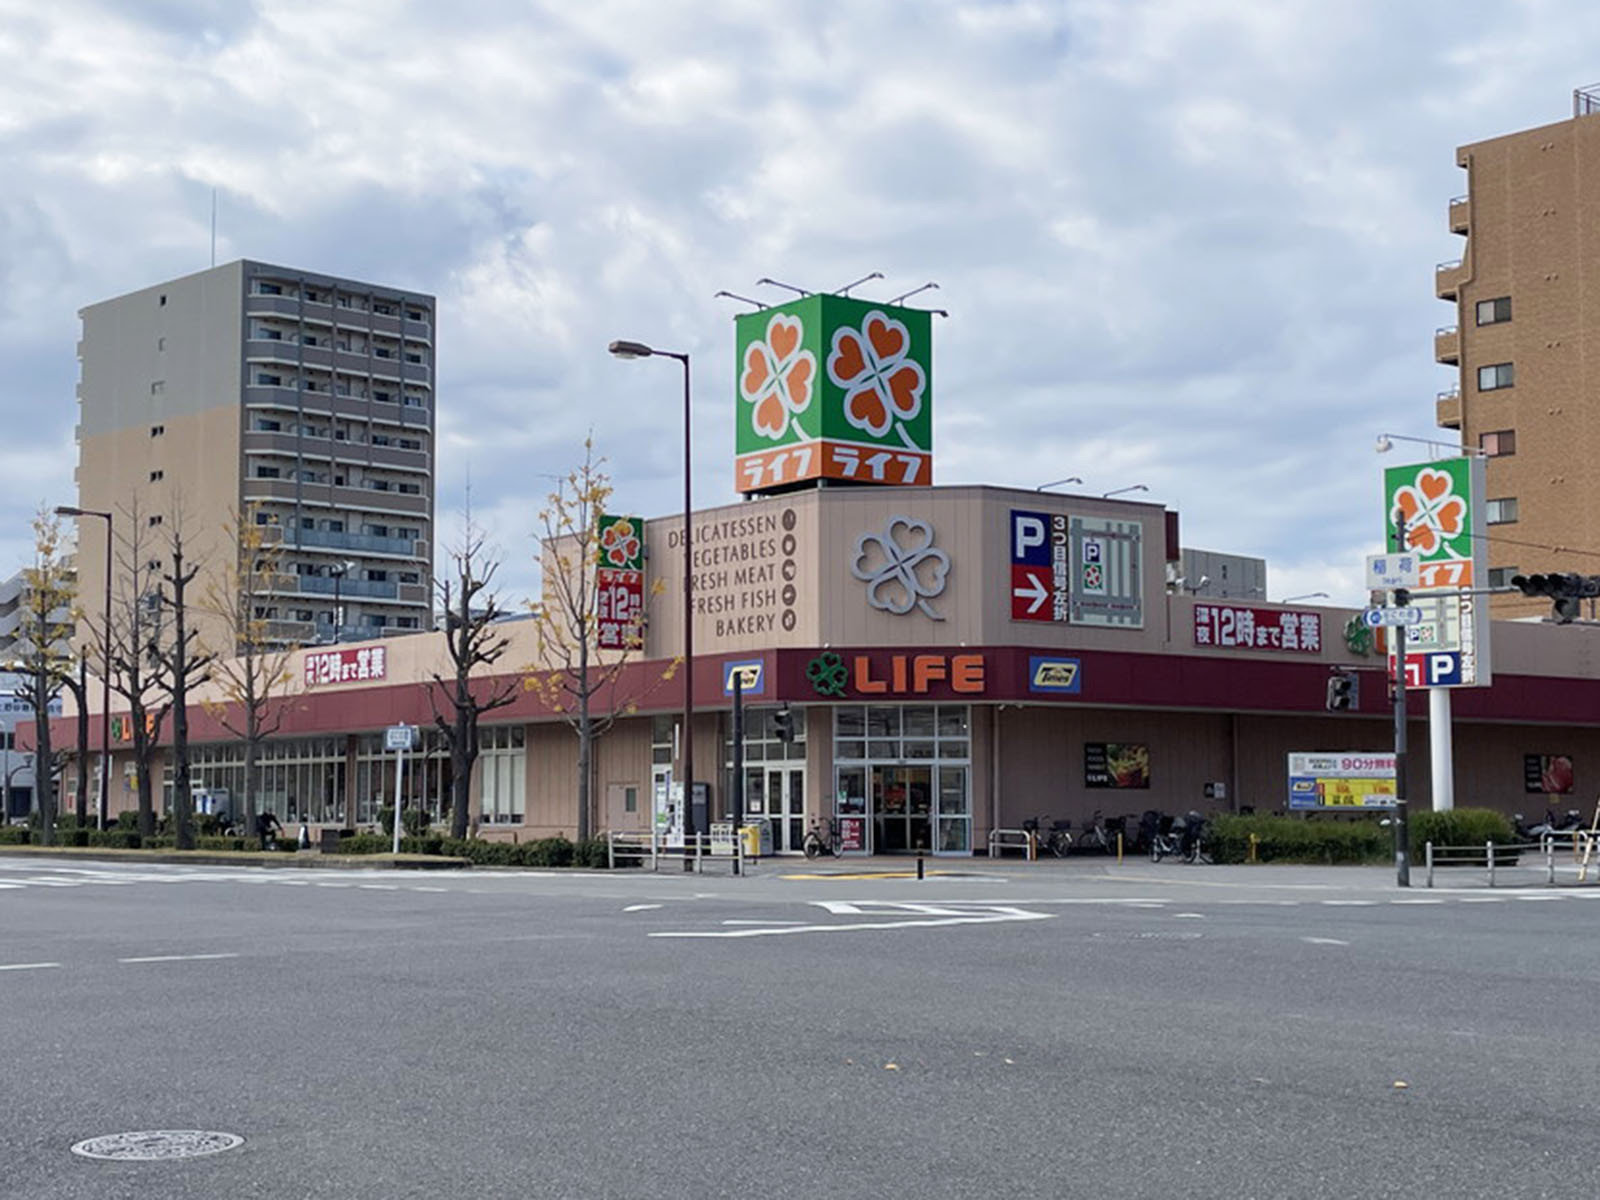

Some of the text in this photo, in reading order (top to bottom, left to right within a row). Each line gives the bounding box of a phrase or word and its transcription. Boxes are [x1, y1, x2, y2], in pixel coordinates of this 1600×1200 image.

[743, 448, 812, 486] ライフ
[832, 447, 922, 483] ライフ
[668, 515, 776, 549] DEICATESSEN
[1016, 516, 1045, 558] P
[691, 539, 776, 568] EGETABLES
[1087, 545, 1098, 560] P
[691, 563, 775, 591] RESH MEAT
[1420, 563, 1464, 586] イフ
[741, 589, 776, 609] FISH
[716, 613, 776, 637] BAKERY
[855, 655, 984, 693] LIFE
[1431, 655, 1454, 683] P
